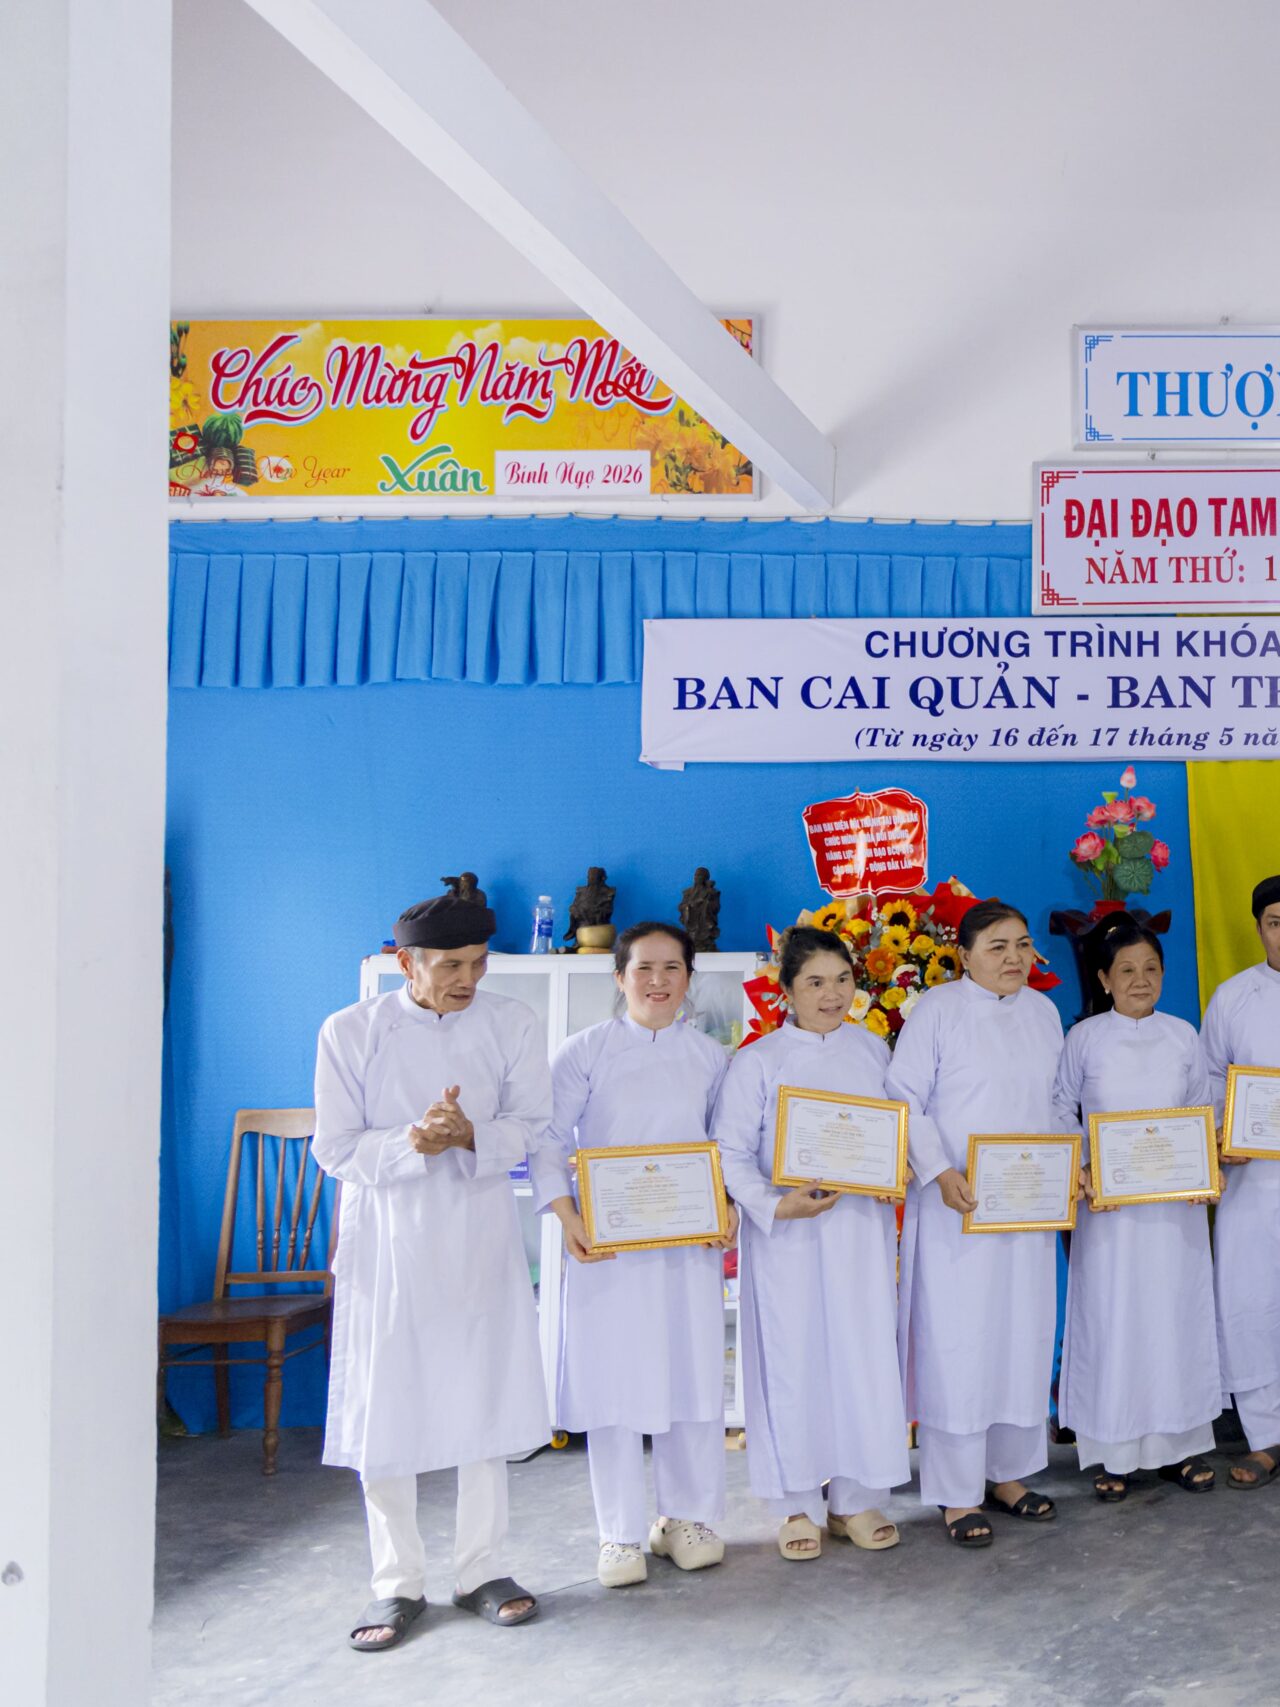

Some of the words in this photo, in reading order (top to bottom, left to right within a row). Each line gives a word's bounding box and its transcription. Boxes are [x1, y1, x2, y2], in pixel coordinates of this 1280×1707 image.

[211, 335, 323, 425] Chúc
[326, 345, 449, 441] Mừng
[409, 341, 553, 420] Năm
[302, 455, 351, 488] Year
[380, 444, 488, 492] Xuân
[504, 461, 549, 485] Bính
[555, 461, 595, 490] Ngọ
[601, 463, 643, 485] 2026
[1063, 497, 1119, 547] ĐẠI
[1130, 497, 1198, 547] ĐẠO
[1208, 496, 1278, 538] TAM
[1085, 549, 1159, 585] NĂM
[1168, 547, 1245, 585] THỨ:
[864, 626, 1031, 659] CHƯƠNG
[1044, 623, 1160, 659] TRÌNH
[672, 675, 784, 711] BAN
[800, 675, 891, 711] CAI
[908, 661, 1061, 718] QUẢN
[1076, 693, 1090, 702] -
[1106, 675, 1216, 710] BAN
[853, 727, 905, 751] (Từ
[911, 728, 979, 753] ngày
[989, 727, 1021, 748] 16
[1027, 724, 1079, 748] đến
[1089, 727, 1121, 748] 17
[1128, 726, 1210, 752] tháng
[1218, 726, 1235, 747] 5
